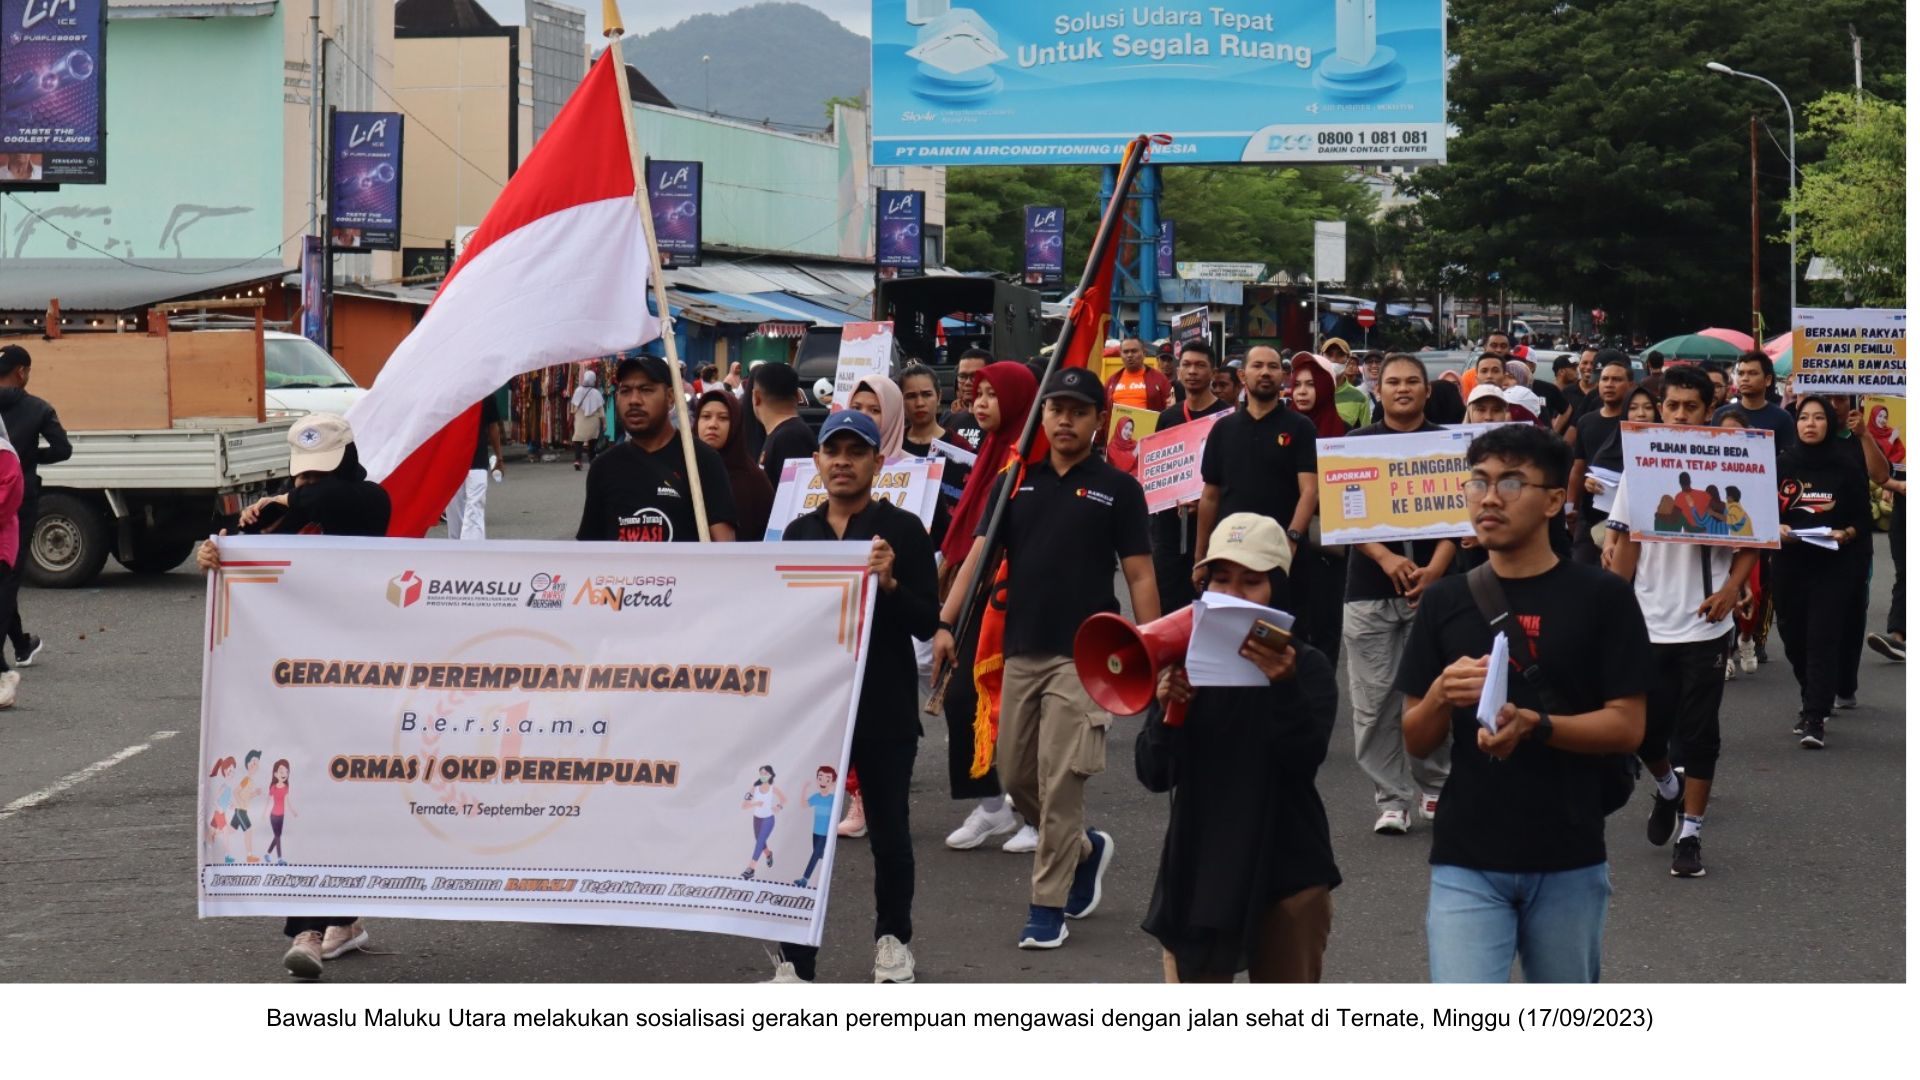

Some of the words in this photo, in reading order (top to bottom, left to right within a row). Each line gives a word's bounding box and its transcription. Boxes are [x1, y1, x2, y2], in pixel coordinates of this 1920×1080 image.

[1054, 8, 1125, 35] Solusi
[1132, 6, 1202, 27] Udara
[1210, 7, 1274, 32] Tepat
[1017, 36, 1103, 68] Untuk
[1112, 32, 1210, 61] Segala
[1220, 34, 1312, 69] Ruang
[1317, 131, 1354, 145] 0800
[1358, 131, 1366, 144] 1
[1371, 130, 1397, 144] 081
[1402, 130, 1428, 144] 081
[896, 146, 917, 157] PT
[918, 146, 972, 157] DAIKIN
[973, 144, 1111, 156] AIRCONDITIONING
[1113, 143, 1198, 155] INNESIA
[1317, 146, 1348, 154] DAIKIN
[1350, 145, 1390, 153] CONTACT
[1392, 145, 1428, 153] CENTER
[1805, 327, 1857, 338] BERSAMA
[1861, 327, 1906, 339] RAKYAT
[1816, 343, 1851, 354] AWASI
[1854, 343, 1896, 355] PEMILU,
[1802, 358, 1854, 369] BERSAMA
[1797, 374, 1854, 385] TEGAKKAN
[1858, 374, 1906, 386] KEADILA
[1145, 443, 1185, 463] GERAKAN
[1650, 442, 1687, 454] PILIHAN
[1690, 444, 1720, 456] BOLEH
[1723, 446, 1749, 458] BEDA
[1145, 454, 1195, 477] PEREMPUAN
[1388, 457, 1472, 478] PELANGGARA
[1635, 456, 1658, 467] TAPI
[1661, 458, 1683, 469] KITA
[1686, 459, 1717, 471] TETAP
[1721, 462, 1766, 474] SAUDARA
[1143, 469, 1193, 492] MENGAWASI
[1326, 470, 1372, 482] LAPORKAN
[1390, 477, 1465, 497] PEMIL
[1392, 498, 1409, 515] KE
[1414, 494, 1468, 513] BAWAS
[428, 579, 522, 596] BAWASLU
[273, 660, 404, 688] GERAKAN
[408, 664, 584, 690] PEREMPUAN
[588, 666, 770, 695] MENGAWASI
[330, 756, 418, 782] ORMAS
[440, 756, 499, 783] OKP
[503, 758, 679, 786] PEREMPUAN
[409, 801, 458, 817] Ternate,
[462, 803, 473, 815] 17
[477, 801, 545, 818] September
[548, 804, 581, 817] 2023
[261, 873, 319, 888] Rakyat
[319, 874, 366, 889] Awasi
[367, 875, 428, 891] Pemilu,
[431, 877, 503, 891] Bersama
[579, 879, 666, 896] Tegakkan
[667, 883, 753, 903] Keadilan
